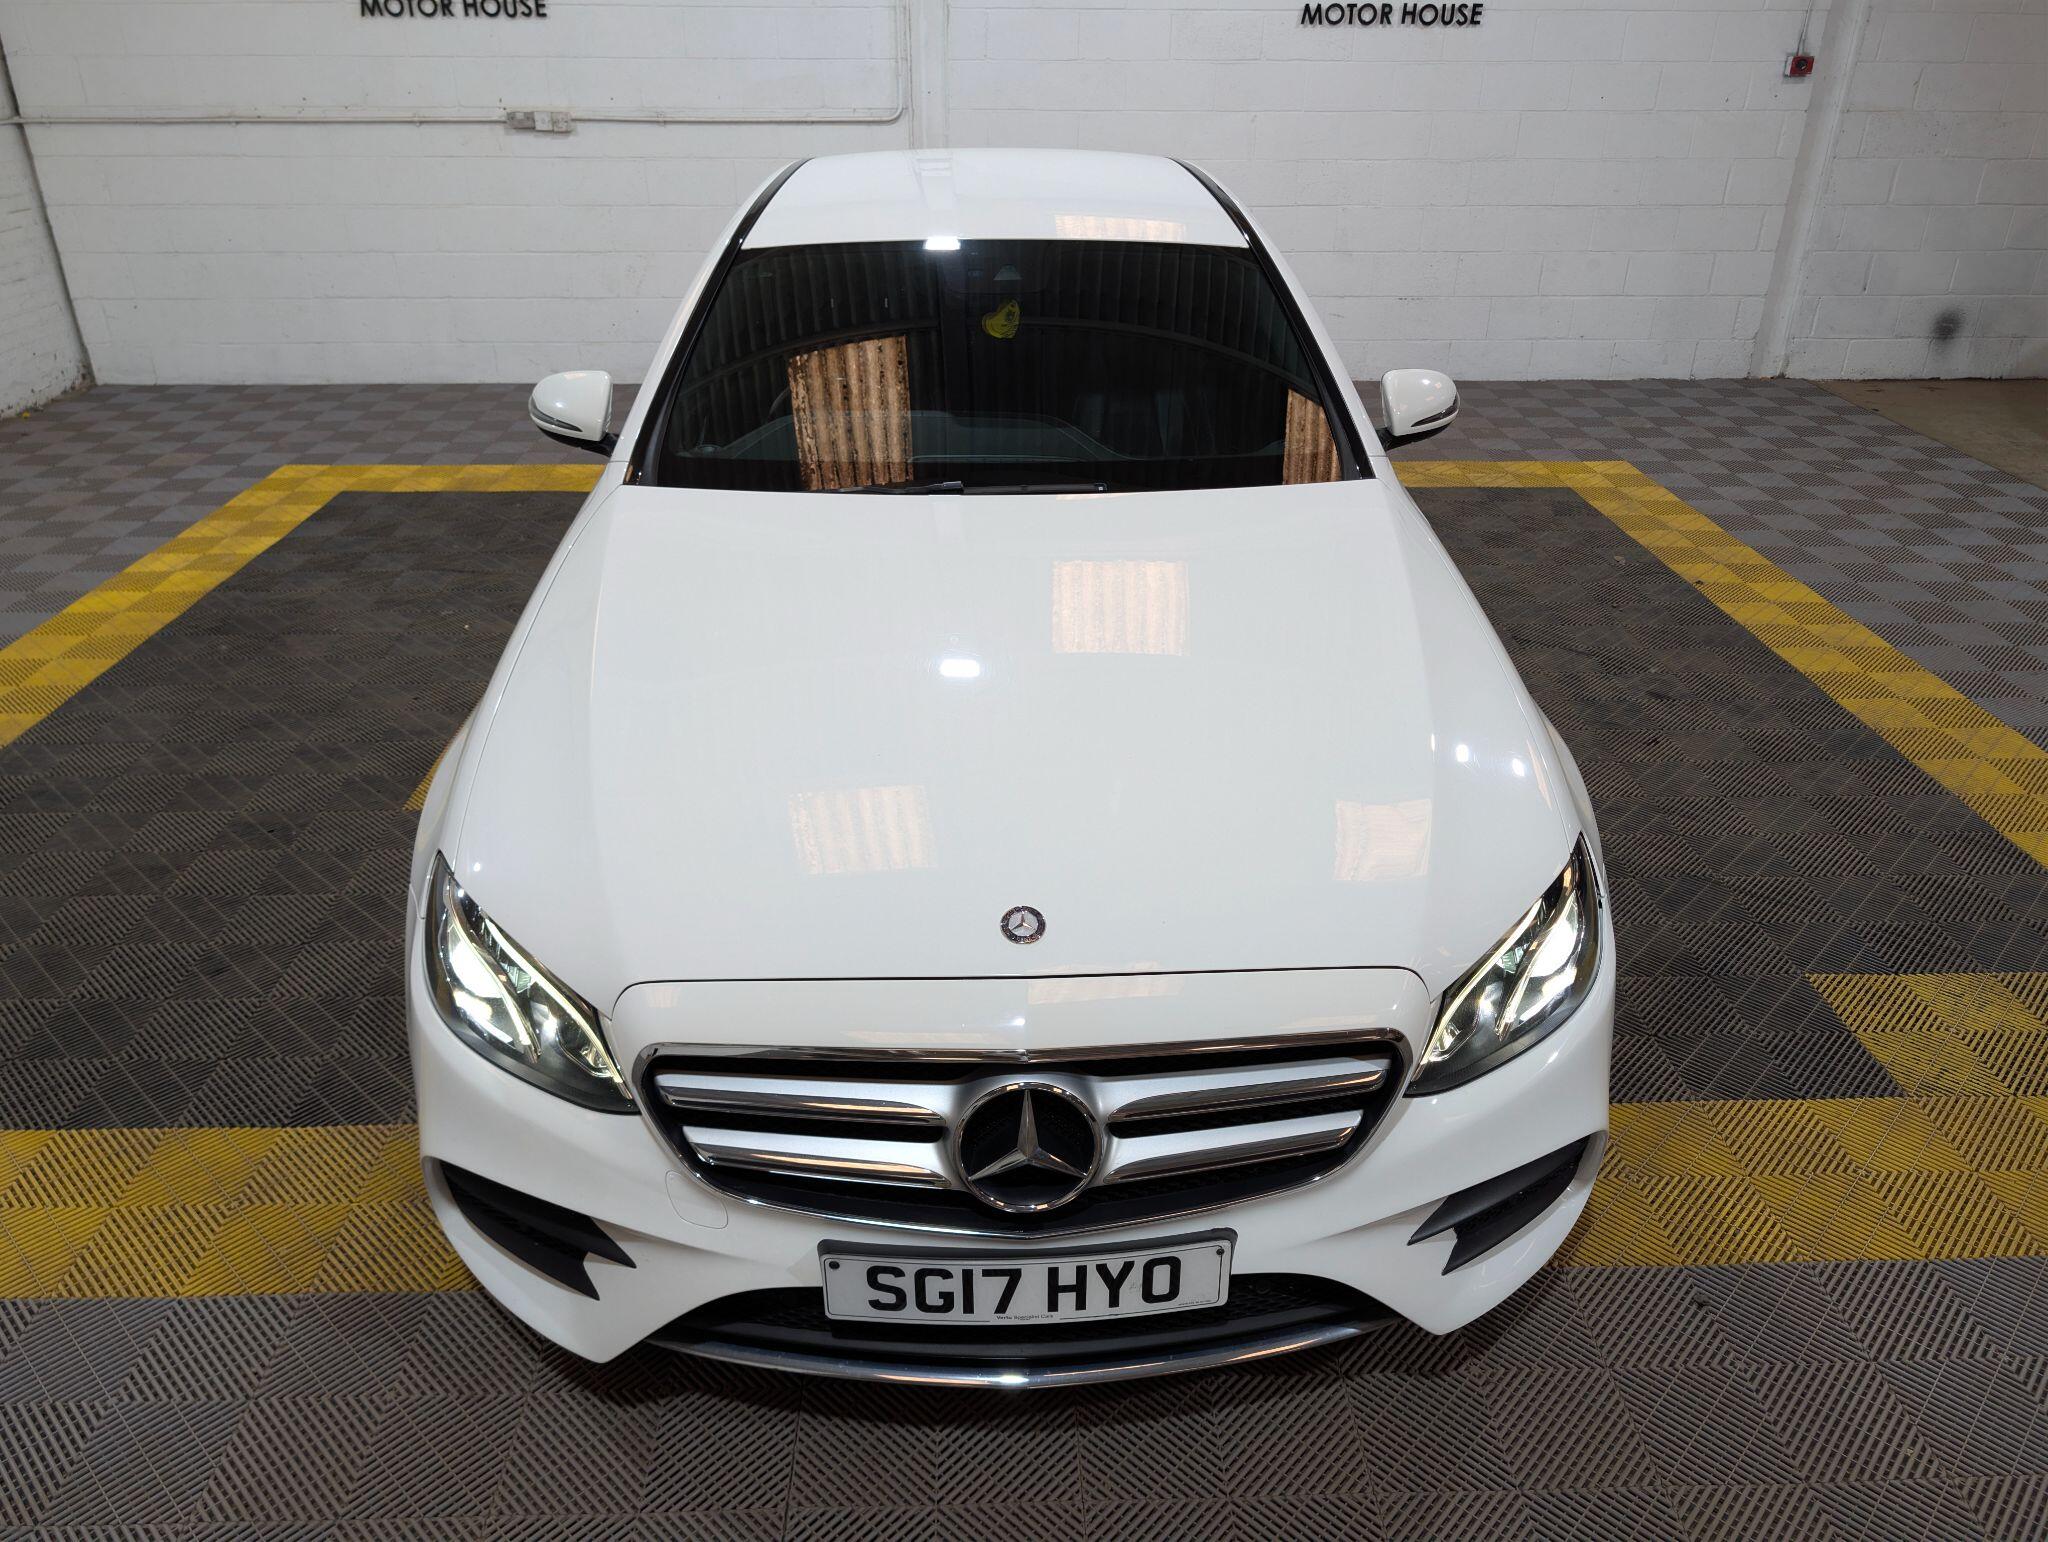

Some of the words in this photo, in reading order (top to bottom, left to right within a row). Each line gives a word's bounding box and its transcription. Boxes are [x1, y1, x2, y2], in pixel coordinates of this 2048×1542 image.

[361, 0, 455, 18] MOTOR
[464, 0, 548, 18] HOUSE
[1300, 3, 1393, 26] MOTOR
[1401, 3, 1484, 26] HOUSE
[866, 1265, 1022, 1314] SG17
[1047, 1255, 1182, 1313] HYO
